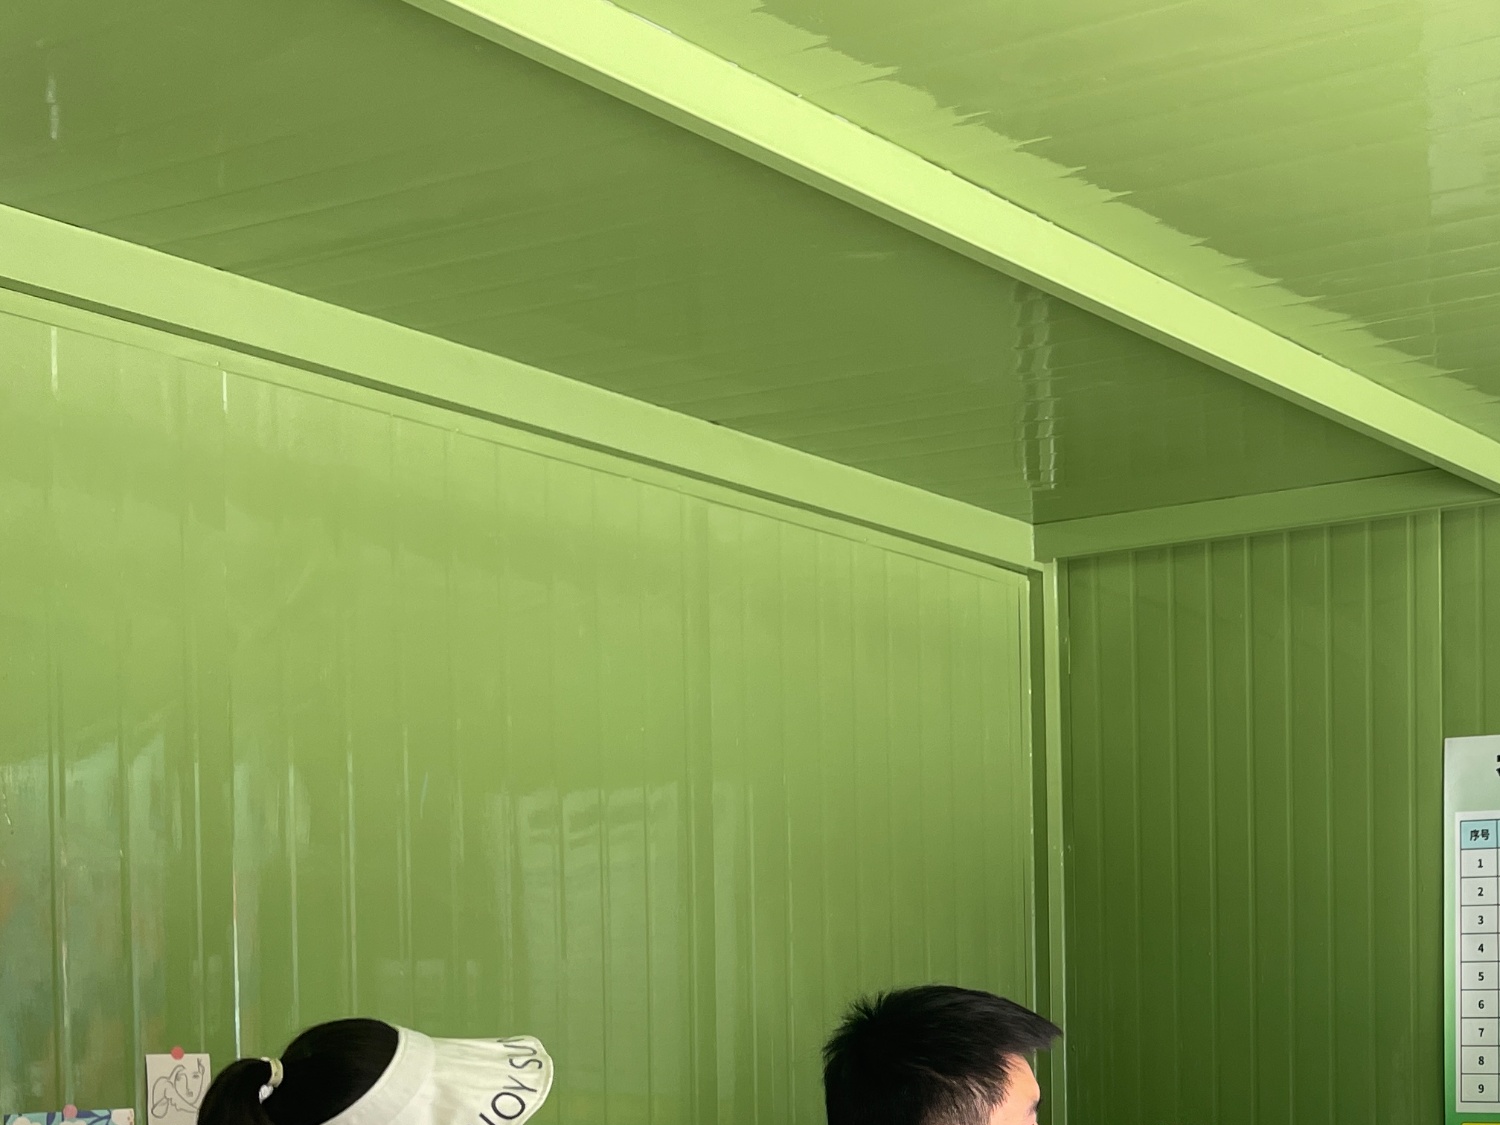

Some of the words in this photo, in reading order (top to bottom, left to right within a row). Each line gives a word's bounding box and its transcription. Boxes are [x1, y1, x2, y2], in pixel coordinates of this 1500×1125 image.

[1469, 828, 1490, 842] 序号
[1477, 858, 1484, 869] 1
[1477, 886, 1484, 897] 2
[1477, 914, 1484, 925] 3
[1477, 943, 1484, 953] 4
[1477, 971, 1485, 982] 5
[1477, 999, 1485, 1010] 6
[1478, 1027, 1485, 1038] 7
[1478, 1055, 1485, 1066] 8
[1477, 1083, 1485, 1094] 9
